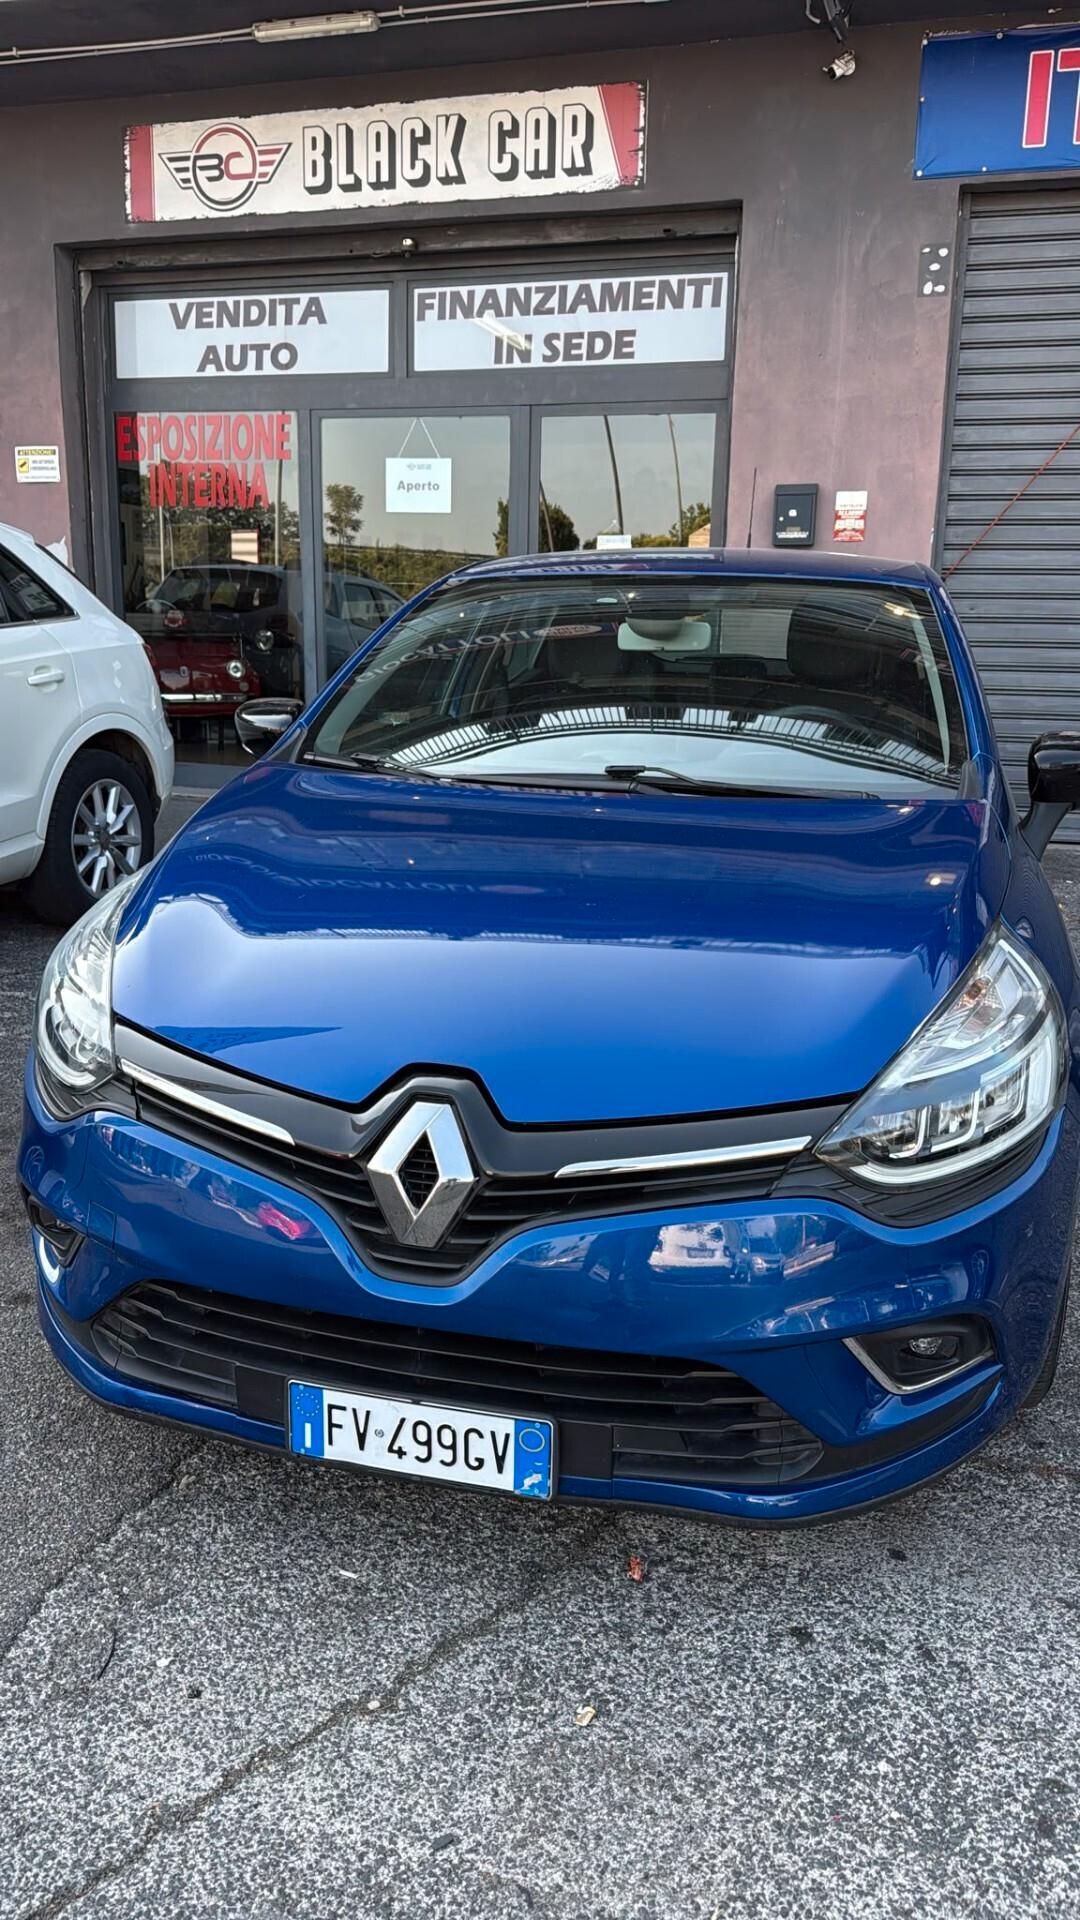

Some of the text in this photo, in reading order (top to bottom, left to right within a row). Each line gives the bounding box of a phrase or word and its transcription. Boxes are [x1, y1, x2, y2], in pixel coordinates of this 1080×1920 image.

[302, 102, 595, 195] BLACK CAR
[168, 296, 328, 331] VENDITA
[416, 276, 724, 322] FINANZIAMENTI
[197, 341, 299, 372] AUTO
[493, 328, 637, 365] IN SEDE
[116, 413, 292, 462] ESPOSIZIONE
[149, 461, 270, 510] INTERNA
[397, 479, 440, 494] Aperto
